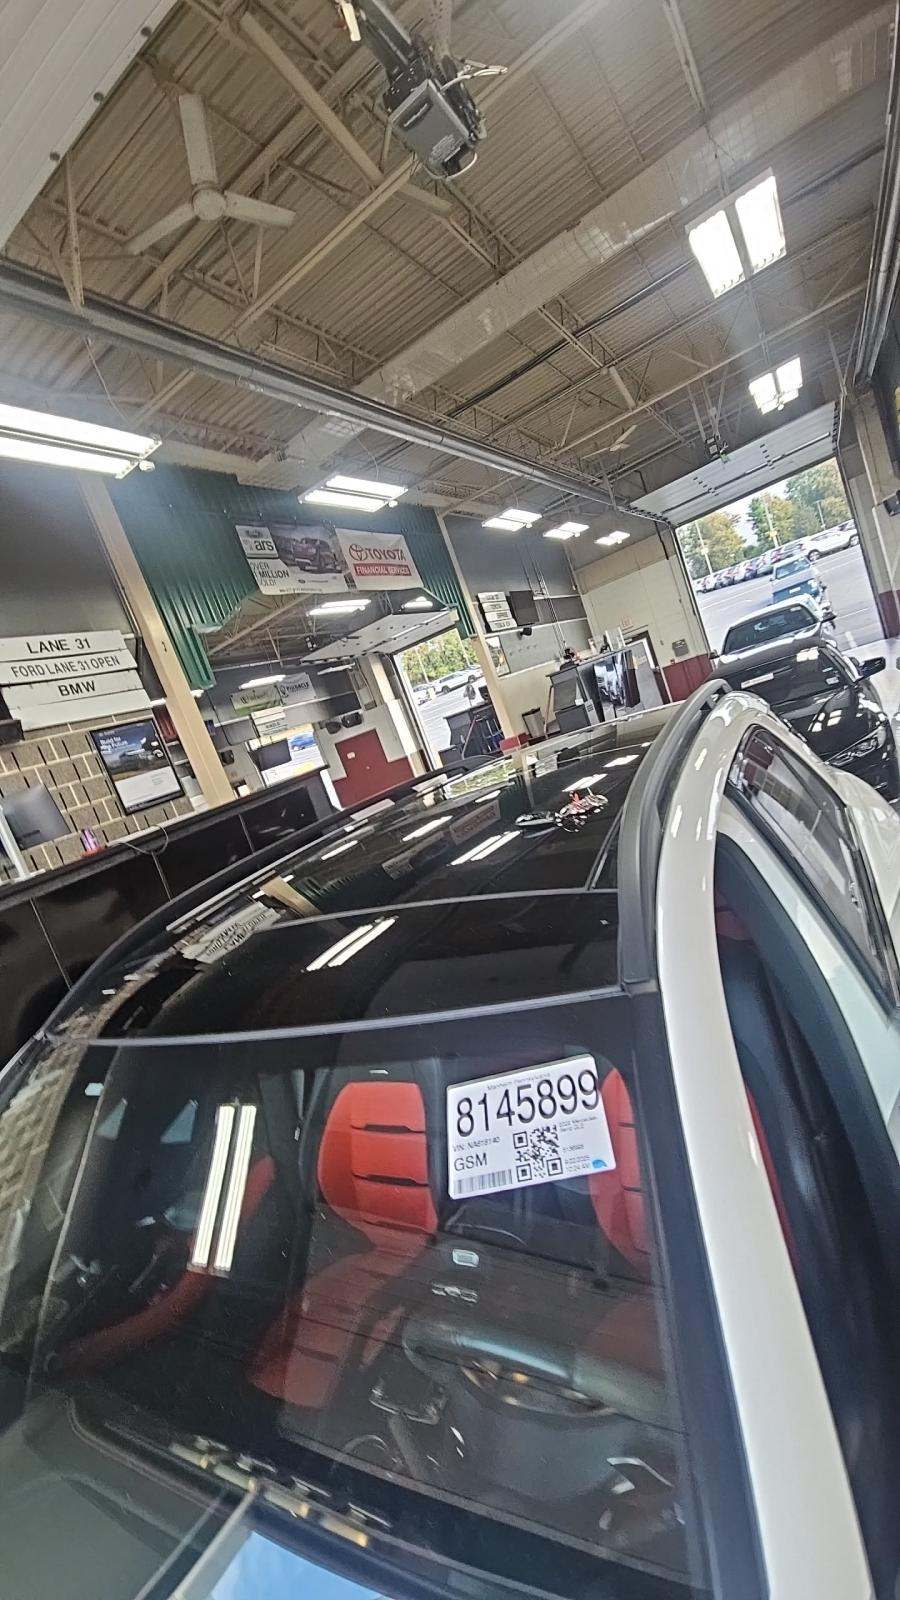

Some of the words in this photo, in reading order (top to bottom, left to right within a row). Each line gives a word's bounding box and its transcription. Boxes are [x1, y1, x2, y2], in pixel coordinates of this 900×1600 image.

[365, 548, 406, 561] TOYOTA
[356, 565, 388, 575] FINANCIAL
[389, 566, 411, 575] SERVICES
[26, 638, 70, 654] LANE
[75, 637, 92, 650] 31
[11, 663, 46, 678] FORD
[47, 660, 77, 675] LANE
[77, 659, 92, 671] 31
[92, 655, 121, 669] OPEN
[58, 680, 97, 697] BMW
[456, 1069, 600, 1137] 8145899
[454, 1152, 488, 1171] GSM
